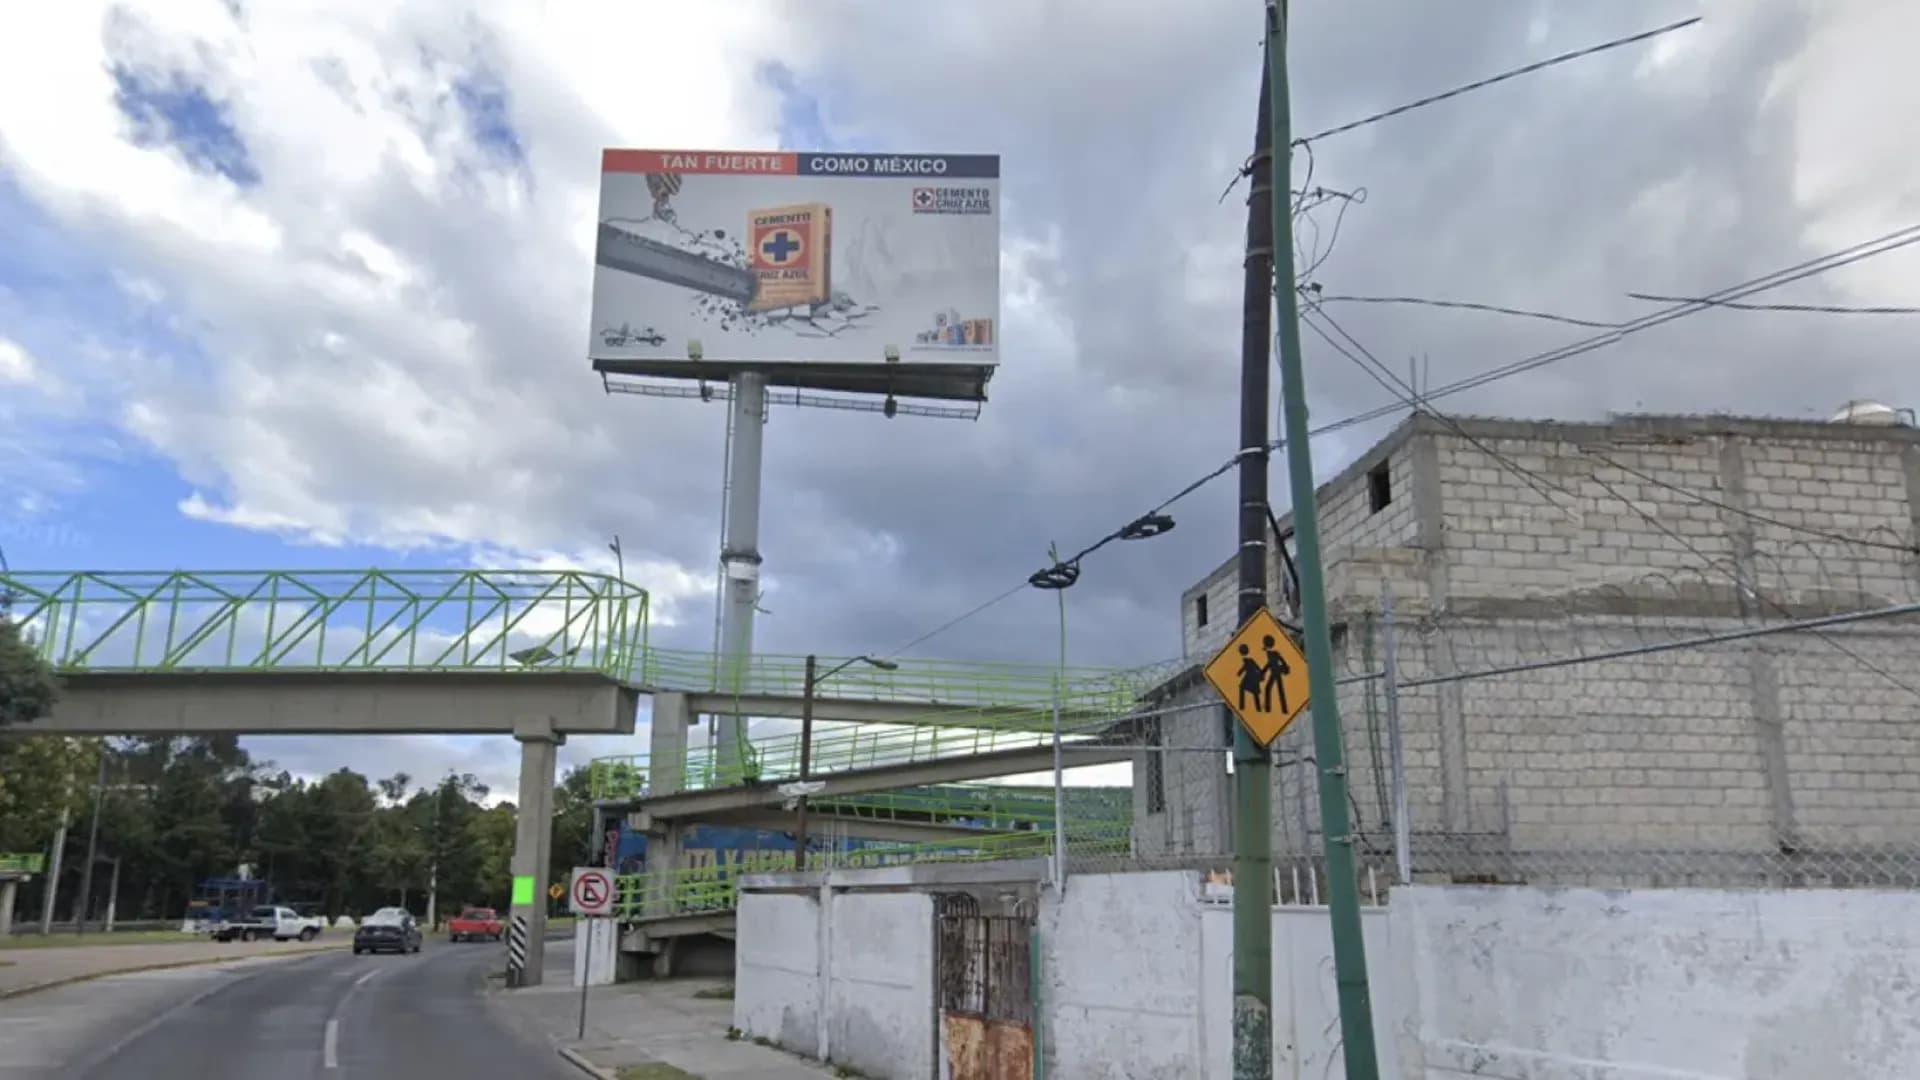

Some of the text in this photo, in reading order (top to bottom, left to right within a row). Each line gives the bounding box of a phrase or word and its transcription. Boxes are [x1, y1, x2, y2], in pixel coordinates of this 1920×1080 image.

[662, 154, 948, 174] TAN FUERTE COMO MÉXICO
[935, 188, 990, 199] CEMENTO
[935, 200, 990, 209] CRUZ AZUL
[754, 212, 811, 225] CEMENTO
[782, 270, 809, 280] AZUL
